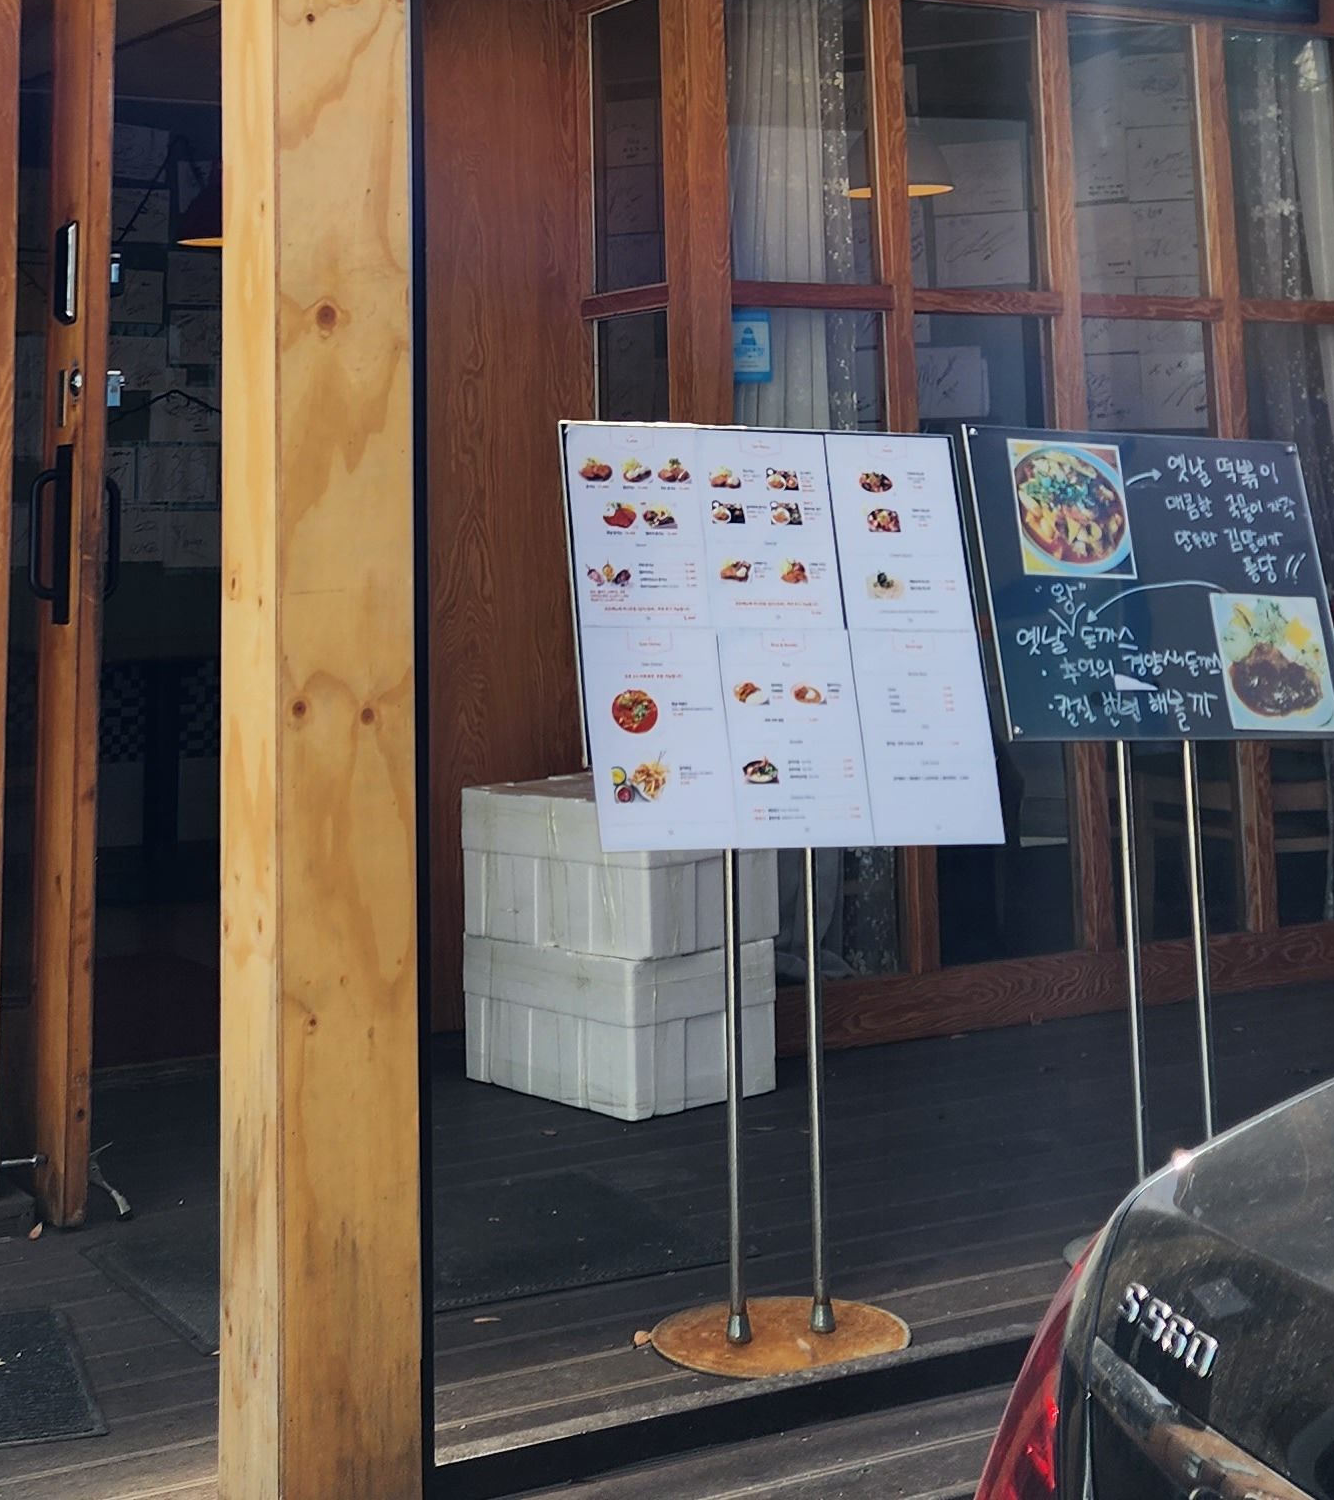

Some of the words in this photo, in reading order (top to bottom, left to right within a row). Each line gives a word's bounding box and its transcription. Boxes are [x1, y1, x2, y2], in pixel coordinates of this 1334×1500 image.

[1166, 453, 1213, 488] 옛날
[1216, 457, 1279, 490] 떡볶이
[1164, 492, 1214, 521] 매콤한
[1225, 493, 1263, 524] 국물이
[1223, 528, 1284, 554] 김말이가
[1016, 625, 1069, 656] 옛날
[1080, 626, 1139, 651] 돈까스
[1059, 657, 1116, 685] 추억의
[1054, 694, 1097, 727] 칼질
[1118, 1281, 1220, 1380] S560
